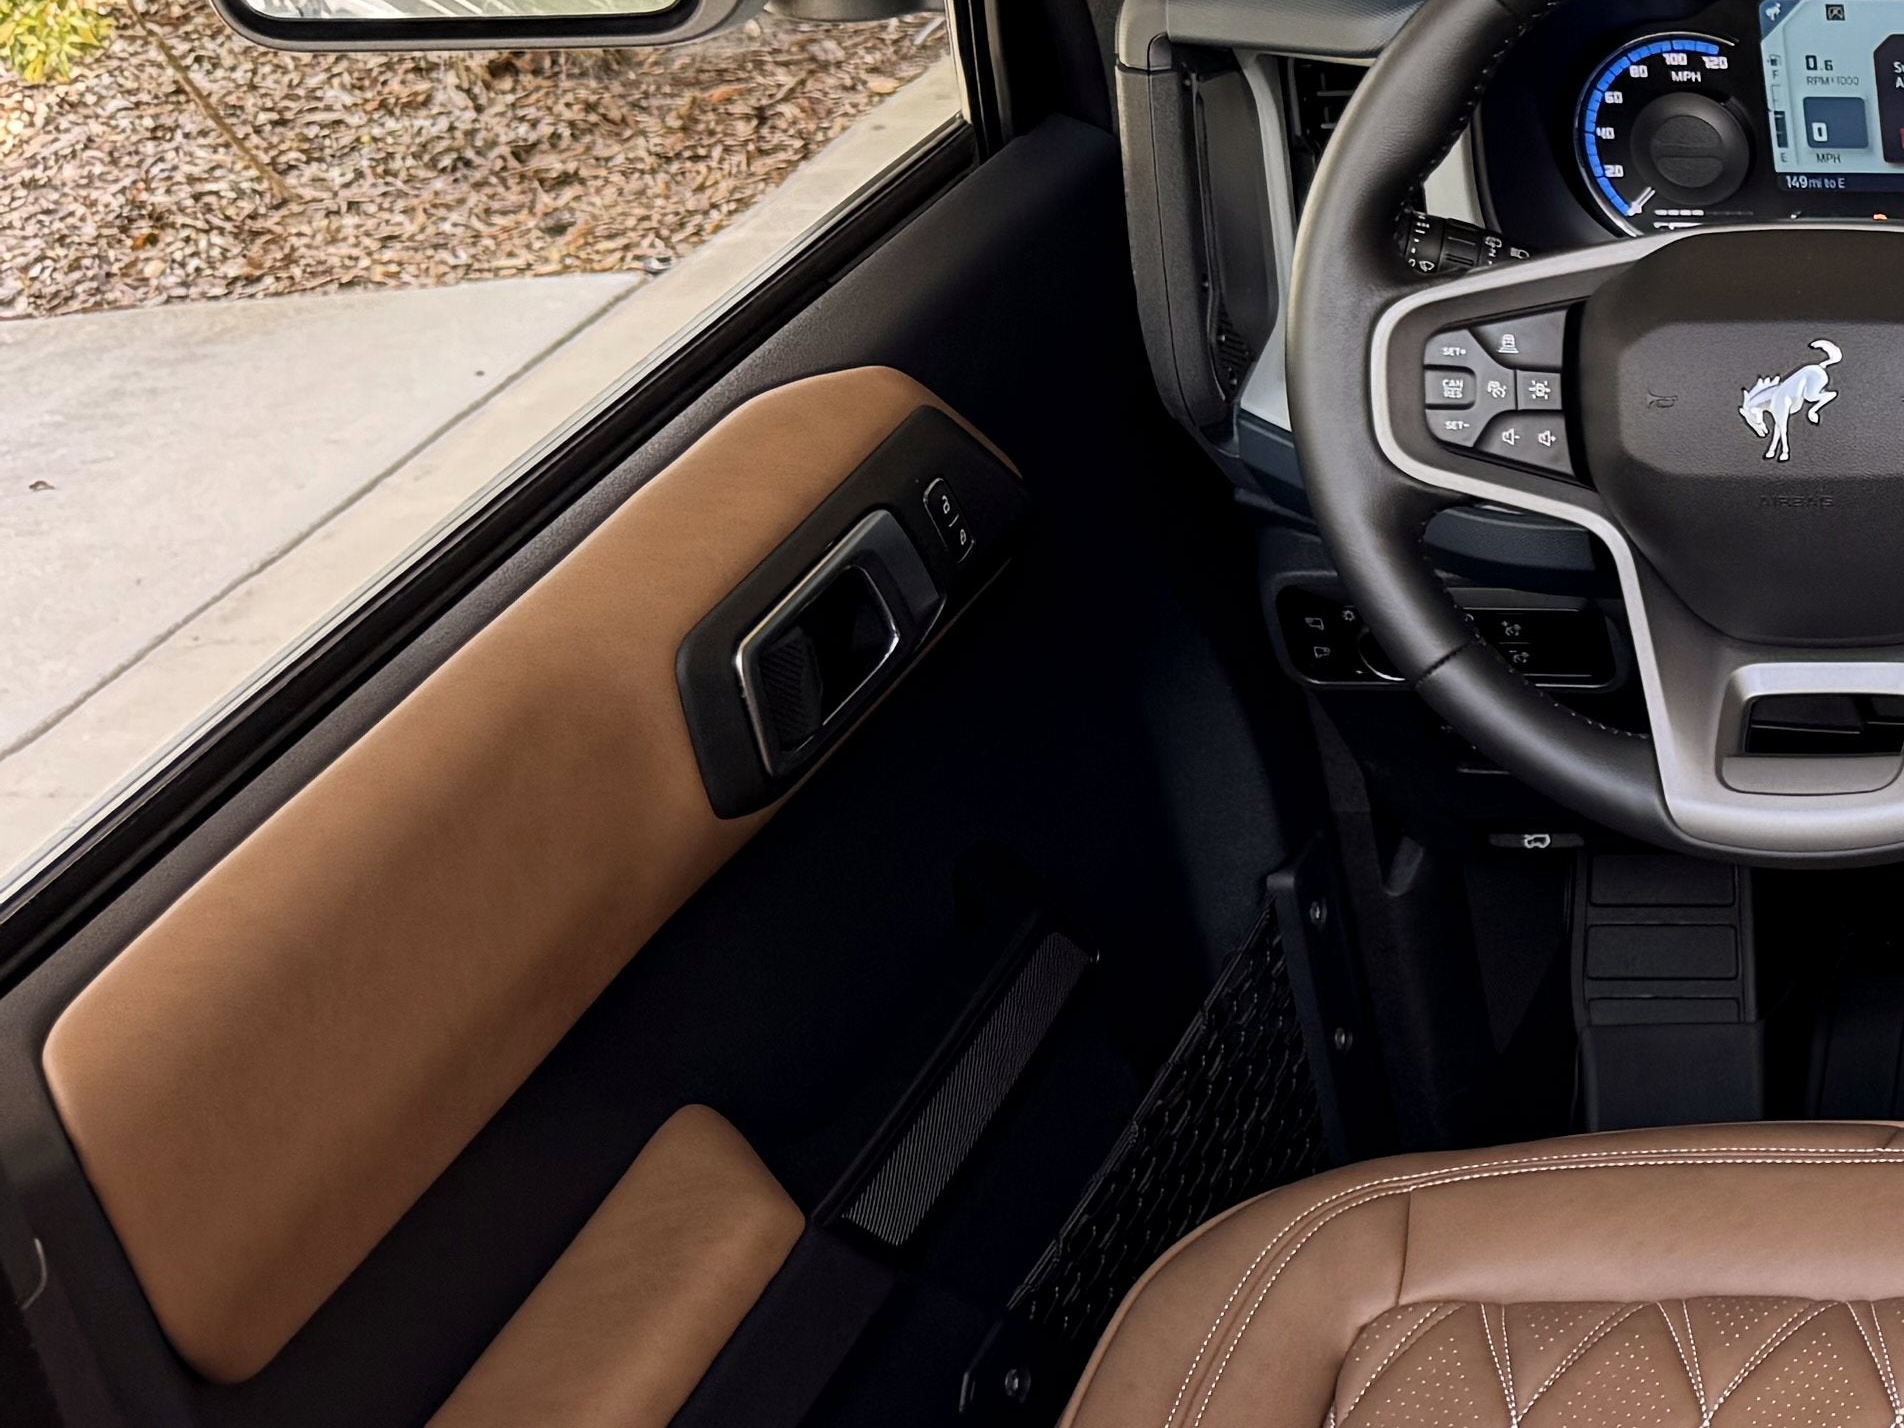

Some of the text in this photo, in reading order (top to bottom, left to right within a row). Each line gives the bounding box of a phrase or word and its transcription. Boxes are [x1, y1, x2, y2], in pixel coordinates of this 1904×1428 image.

[1662, 53, 1688, 65] 100
[1702, 56, 1728, 69] 120
[1629, 65, 1648, 77] 80
[1671, 71, 1701, 82] MPH
[1604, 91, 1623, 104] 60
[1596, 127, 1615, 139] 40
[1812, 122, 1828, 142] 0
[1816, 153, 1841, 163] MPH
[1604, 165, 1624, 177] 20
[1824, 175, 1836, 189] to
[1838, 176, 1846, 189] E
